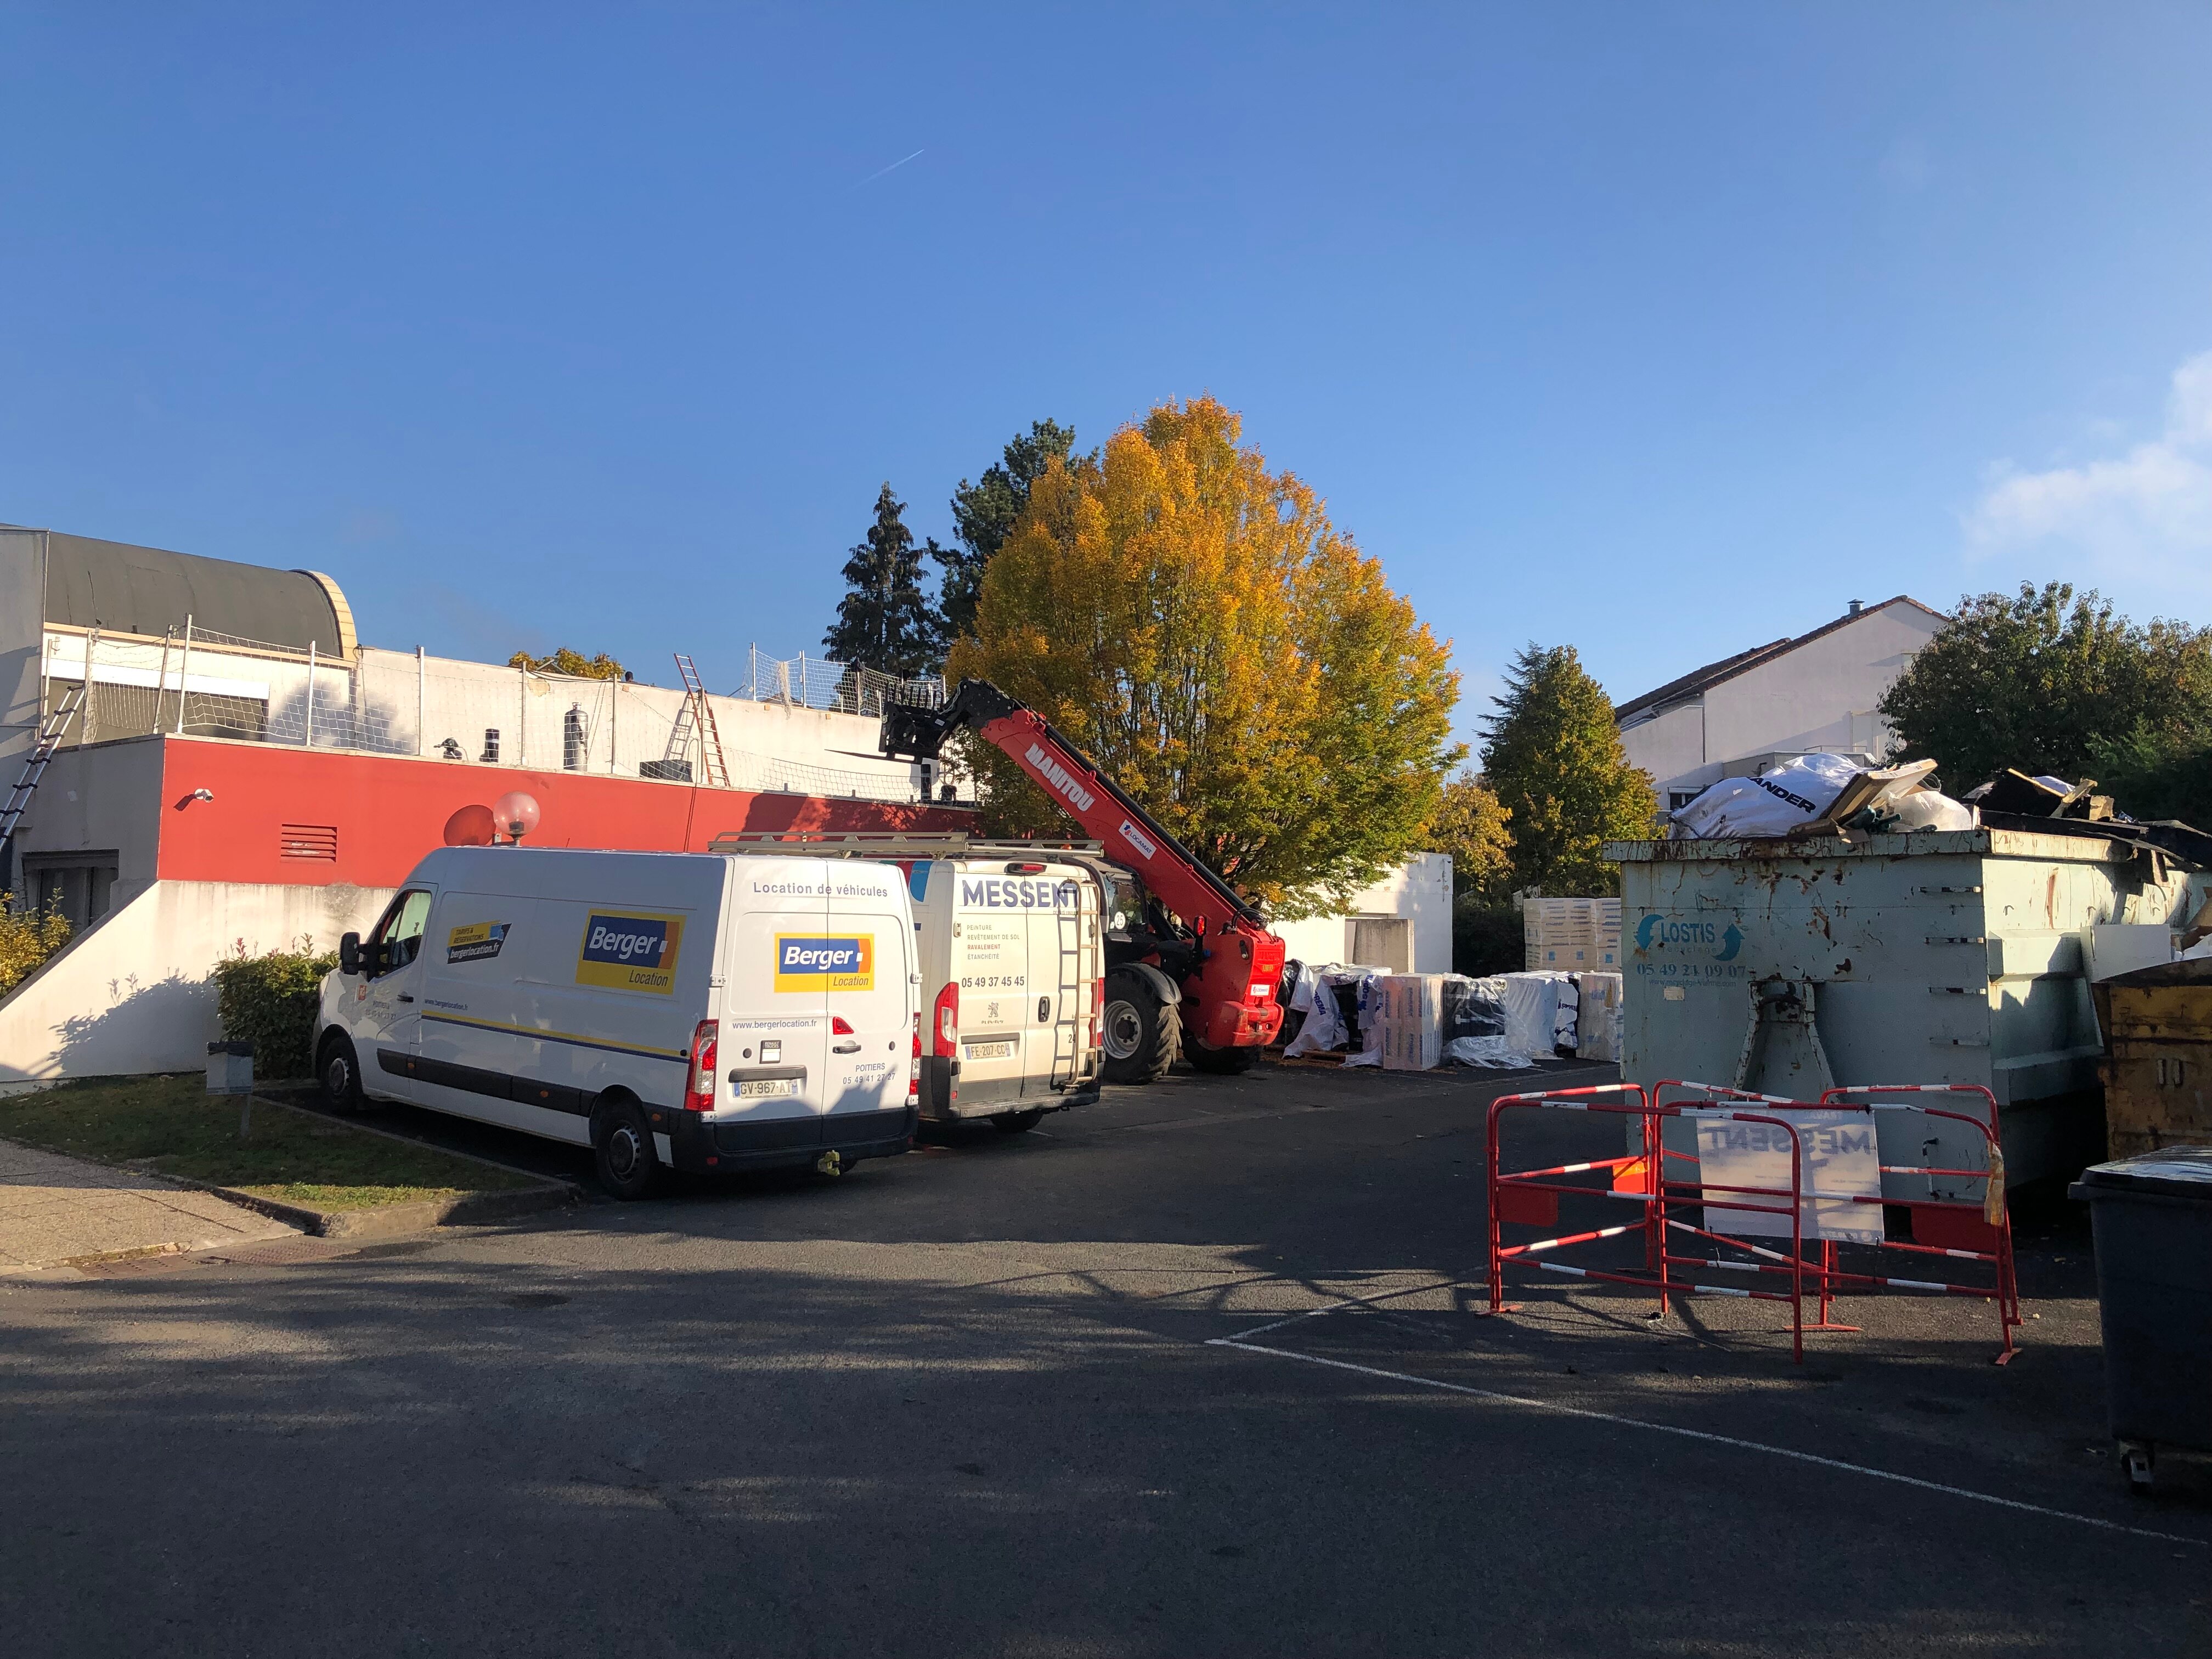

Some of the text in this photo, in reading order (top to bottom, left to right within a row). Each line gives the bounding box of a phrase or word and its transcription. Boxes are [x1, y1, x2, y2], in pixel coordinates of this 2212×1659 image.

[1025, 742, 1096, 811] MANITOU
[1129, 831, 1153, 854] LOCAMAT
[753, 882, 888, 897] Location de véhicules
[1116, 915, 1124, 926] 25
[1660, 923, 1716, 943] LOSTIS
[589, 926, 658, 960] Berger
[450, 943, 500, 959] bergerlocation.fr
[784, 946, 854, 970] Berger
[629, 969, 669, 987] Location
[1637, 963, 1746, 978] 05 49 21 09 07
[833, 975, 869, 986] Location
[961, 975, 1025, 988] 05 49 37 45 45
[732, 1019, 817, 1030] www.bergerlocation.fr
[970, 1044, 1006, 1057] FE-207-CC
[855, 1063, 885, 1072] POITIERS
[741, 1081, 792, 1094] GV-967-AT
